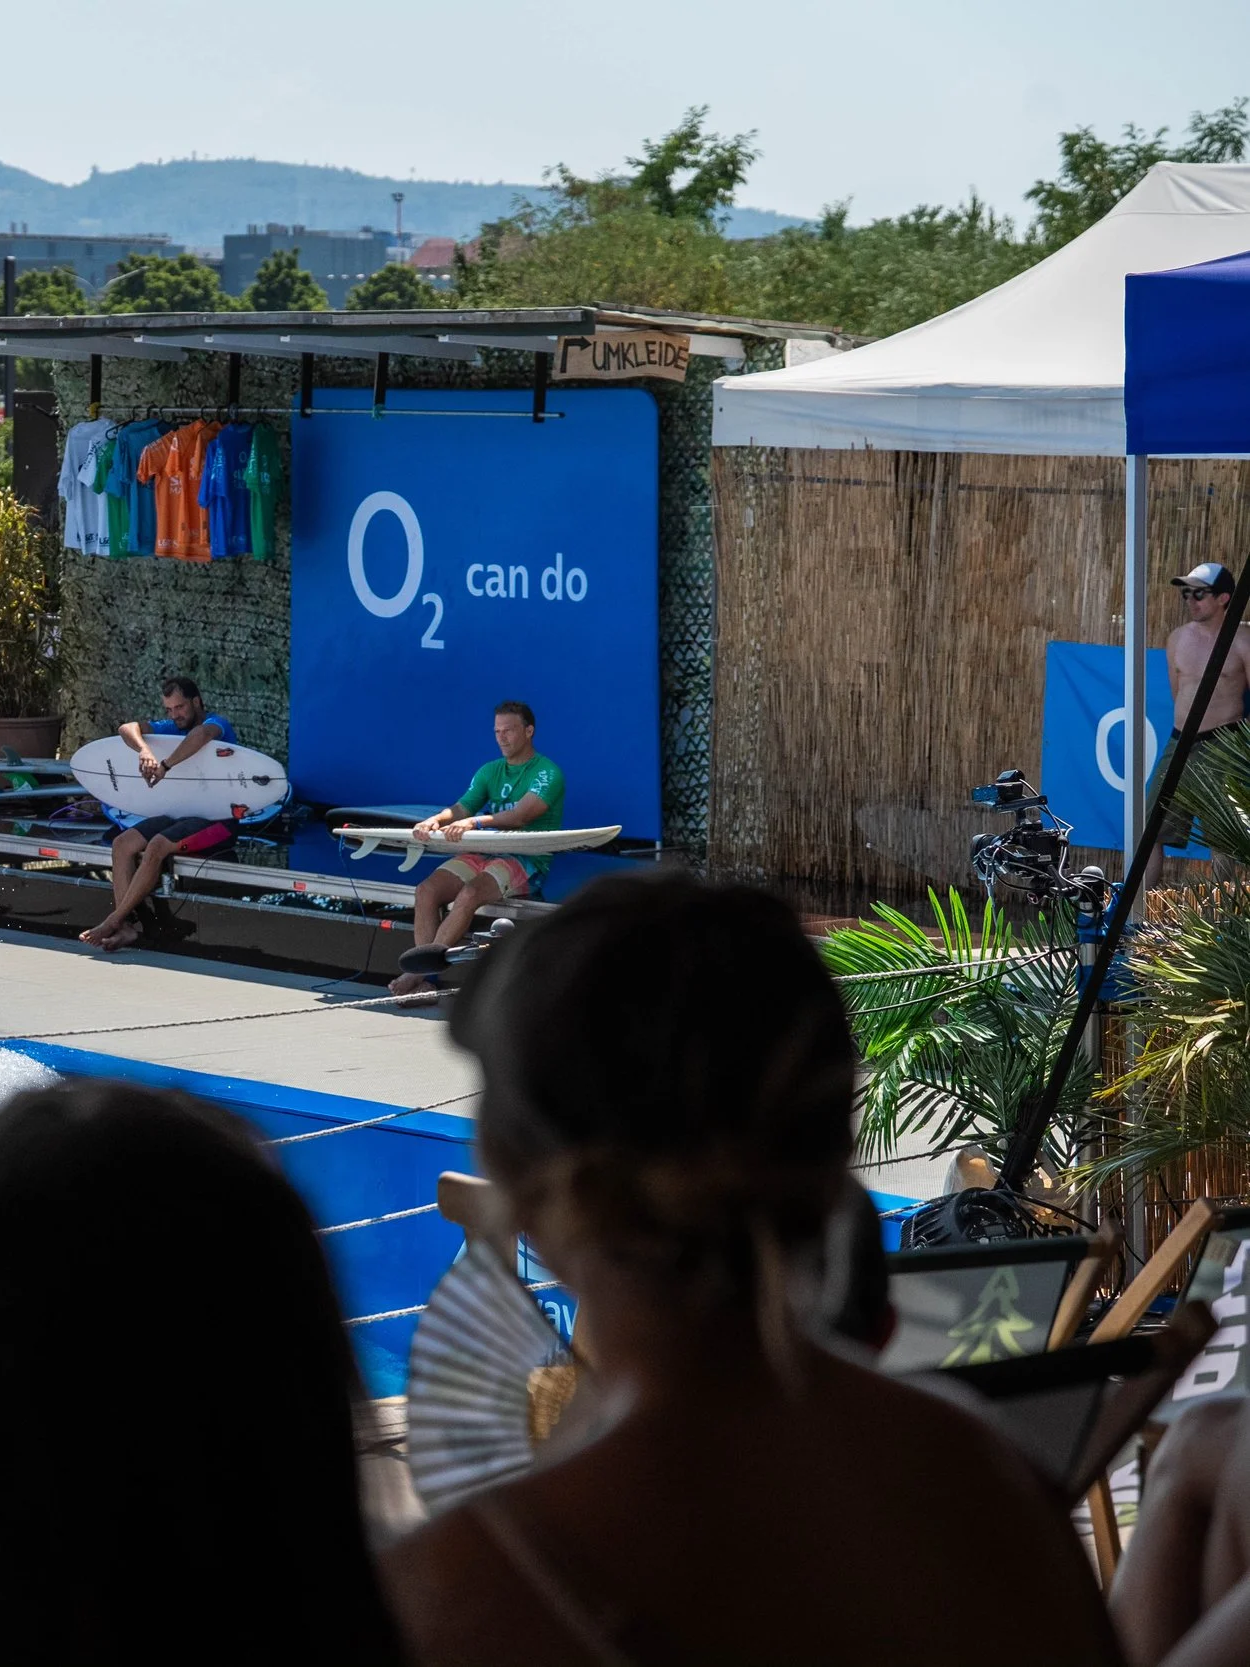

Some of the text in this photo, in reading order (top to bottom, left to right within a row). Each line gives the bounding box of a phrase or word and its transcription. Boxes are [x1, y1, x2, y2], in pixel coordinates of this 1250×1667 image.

[592, 340, 689, 371] UMKLEIDE
[466, 552, 588, 602] can do
